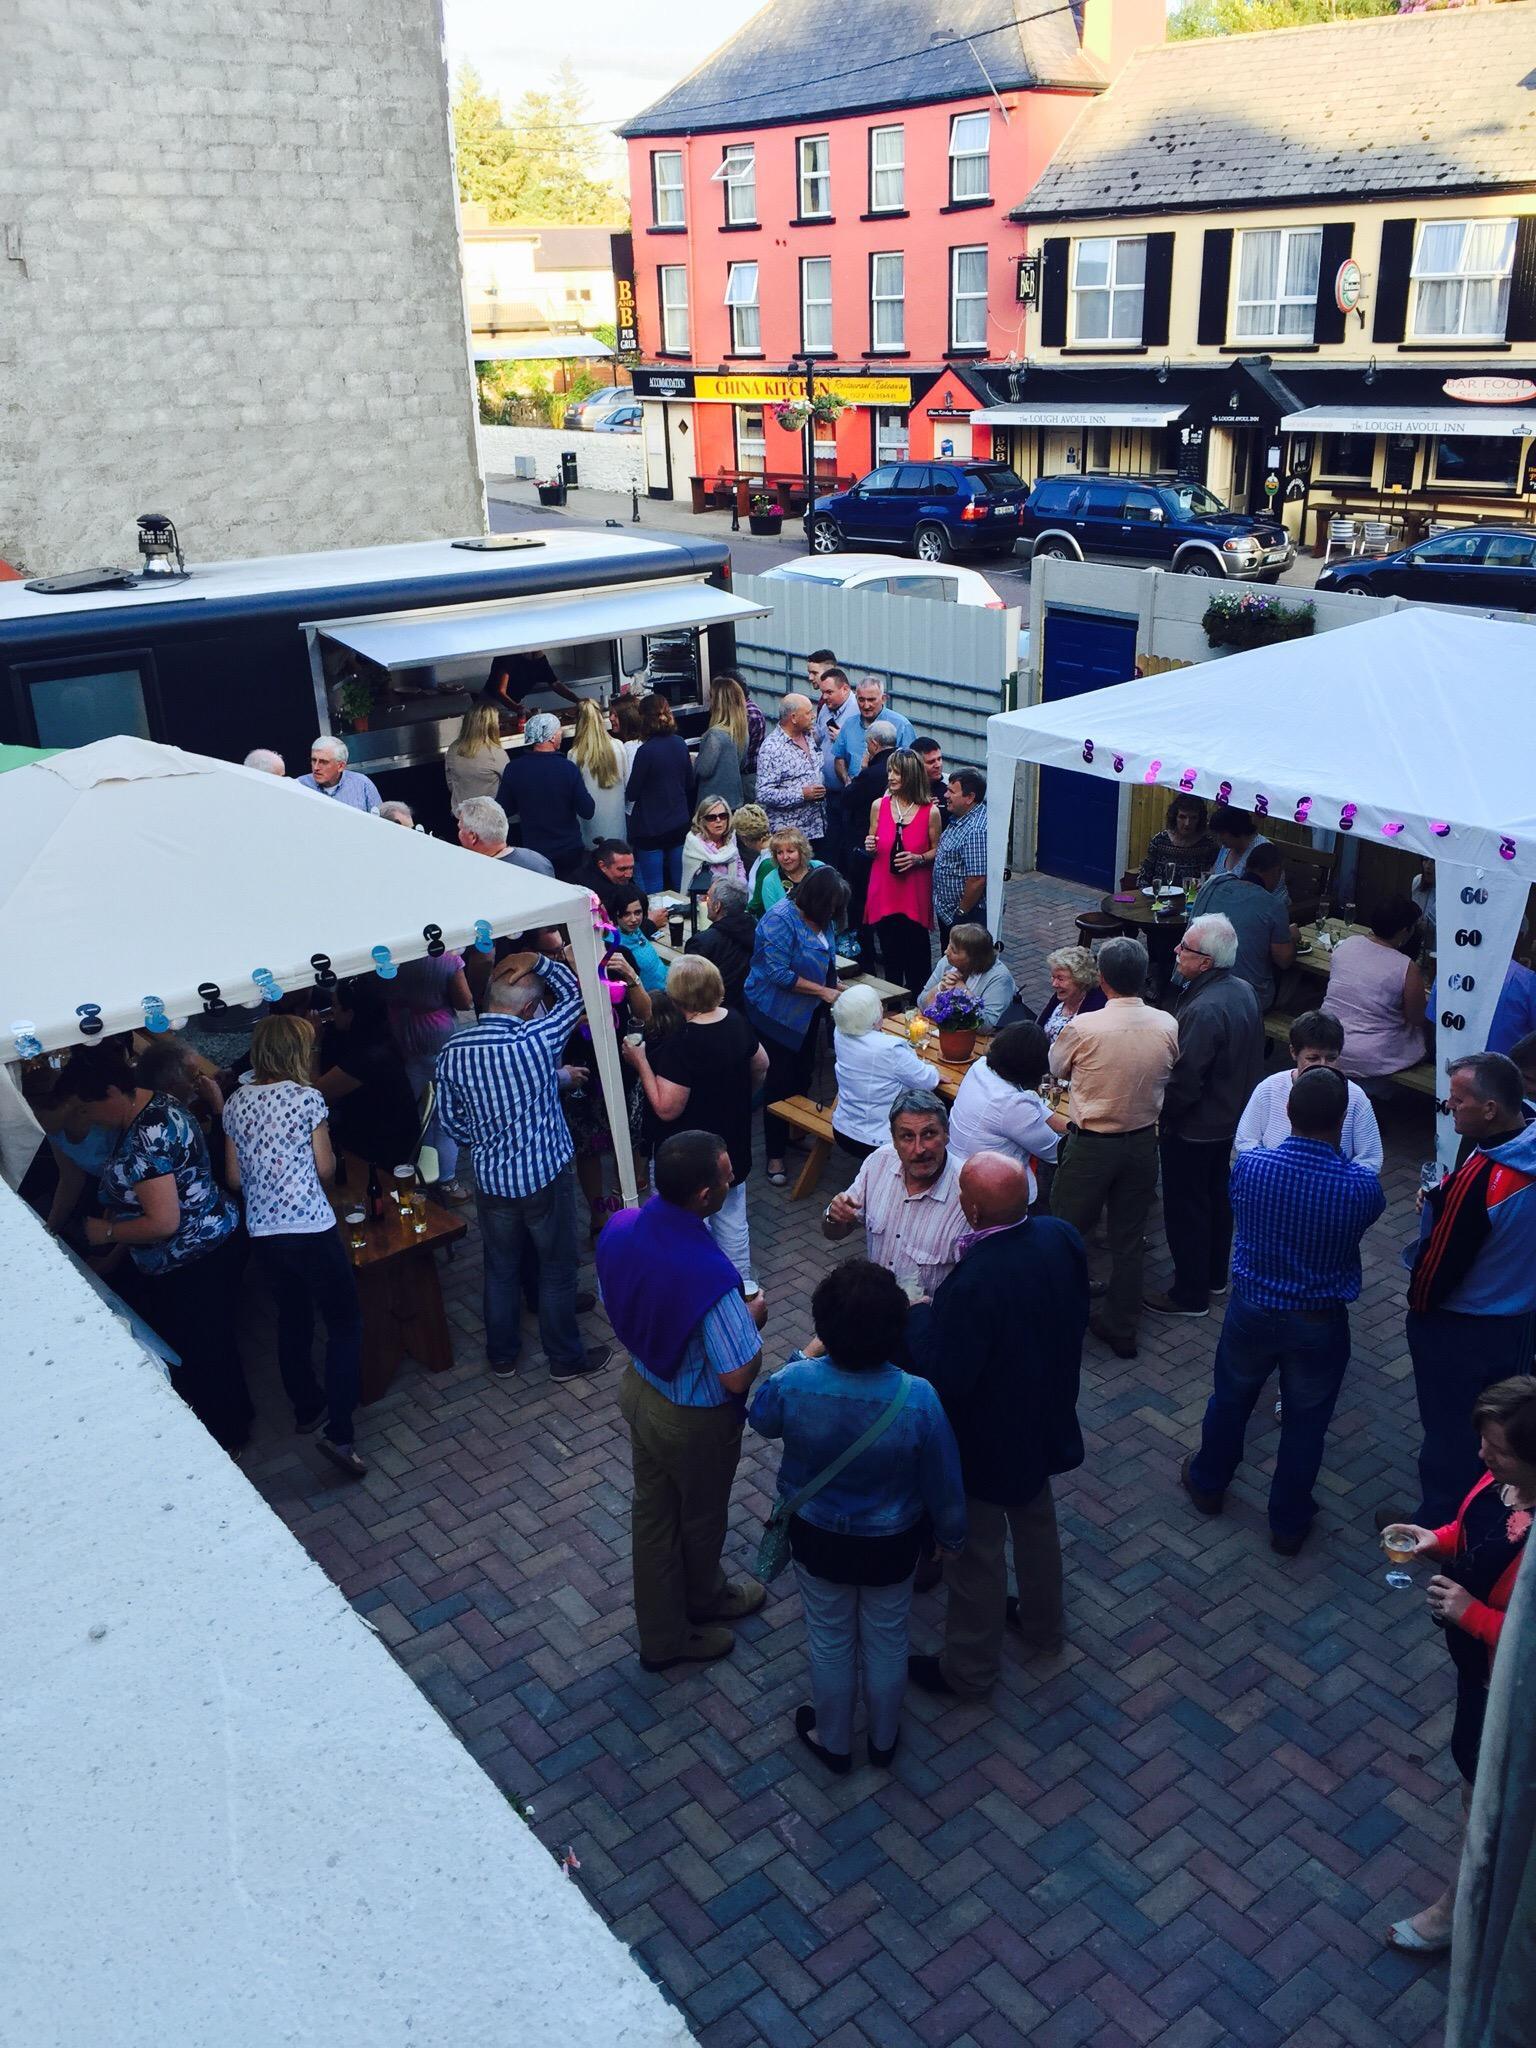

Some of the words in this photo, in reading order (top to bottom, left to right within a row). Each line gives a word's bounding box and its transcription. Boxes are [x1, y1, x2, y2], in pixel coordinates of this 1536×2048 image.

[618, 281, 631, 300] B
[1020, 270, 1035, 297] B&B
[620, 308, 633, 327] B
[621, 329, 634, 338] PUB
[620, 340, 636, 349] GRUB
[715, 380, 761, 395] CHINA
[1447, 380, 1476, 388] BAR
[1484, 380, 1532, 389] FOOD
[1029, 415, 1059, 423] LOUGH
[1061, 415, 1087, 424] AVOUL
[1089, 415, 1106, 424] INN
[1365, 421, 1402, 431] LOUGH
[1405, 422, 1439, 431] AVOUL
[1443, 423, 1466, 432] INN
[1460, 886, 1489, 905] 60
[1455, 928, 1483, 947] 60
[1448, 973, 1475, 992] 60
[1441, 1010, 1466, 1031] 60
